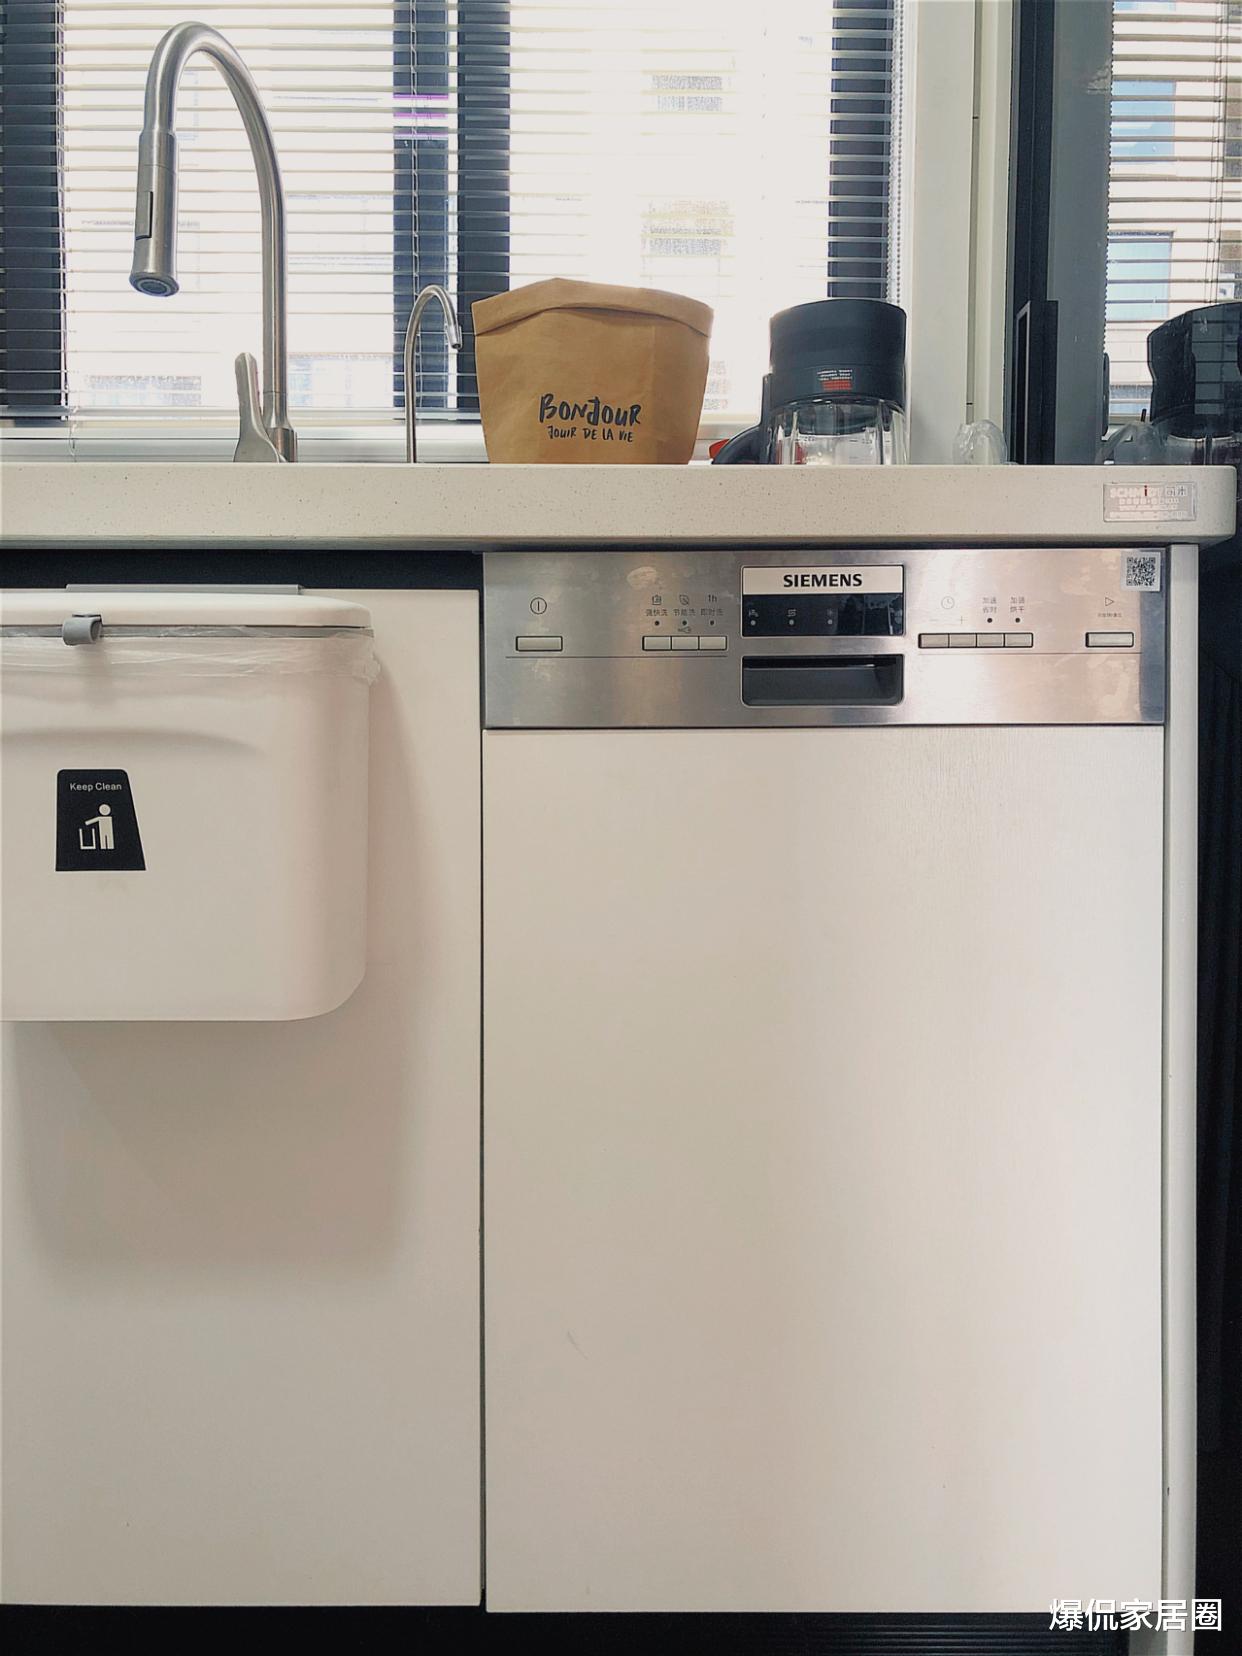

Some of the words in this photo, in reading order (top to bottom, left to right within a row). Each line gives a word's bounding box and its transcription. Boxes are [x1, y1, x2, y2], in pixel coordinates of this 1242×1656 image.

[583, 428, 598, 440] DE
[602, 428, 614, 441] LA
[619, 430, 634, 442] VIE
[783, 573, 863, 588] SIEMENS
[69, 782, 94, 792] Keep
[95, 782, 122, 791] Clean
